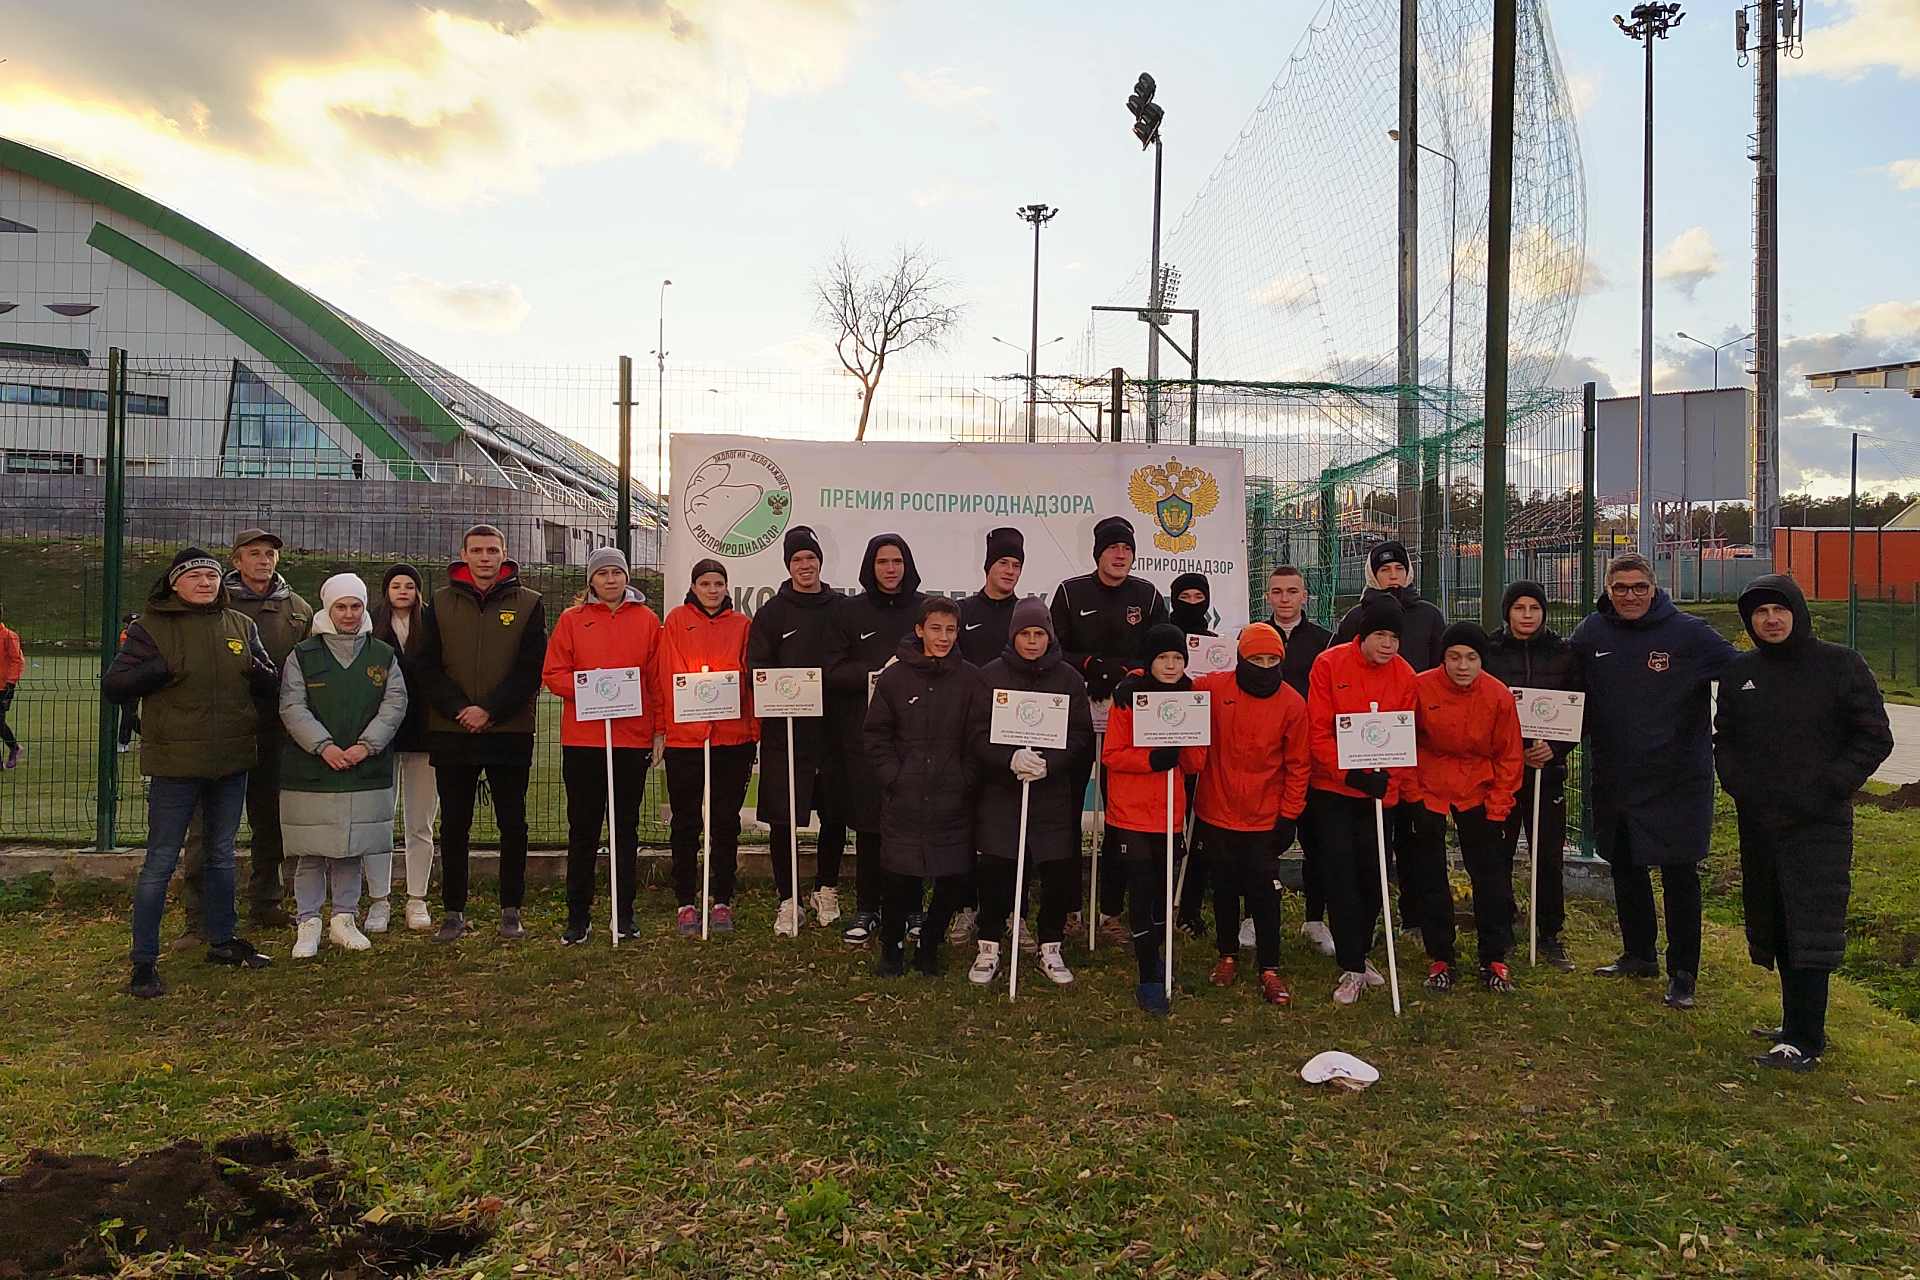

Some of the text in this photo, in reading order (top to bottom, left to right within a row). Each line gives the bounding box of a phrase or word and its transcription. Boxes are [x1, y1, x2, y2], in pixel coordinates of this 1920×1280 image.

[713, 451, 746, 463] ЭКОЛОГИЯ
[750, 454, 768, 467] ДЕЛО
[766, 463, 788, 491] КАЖДОГО
[820, 488, 1096, 518] ПРЕМИЯ РОСПРИРОДНАДЗОРА
[692, 524, 780, 556] РОСПРИРОДНАДЗОР
